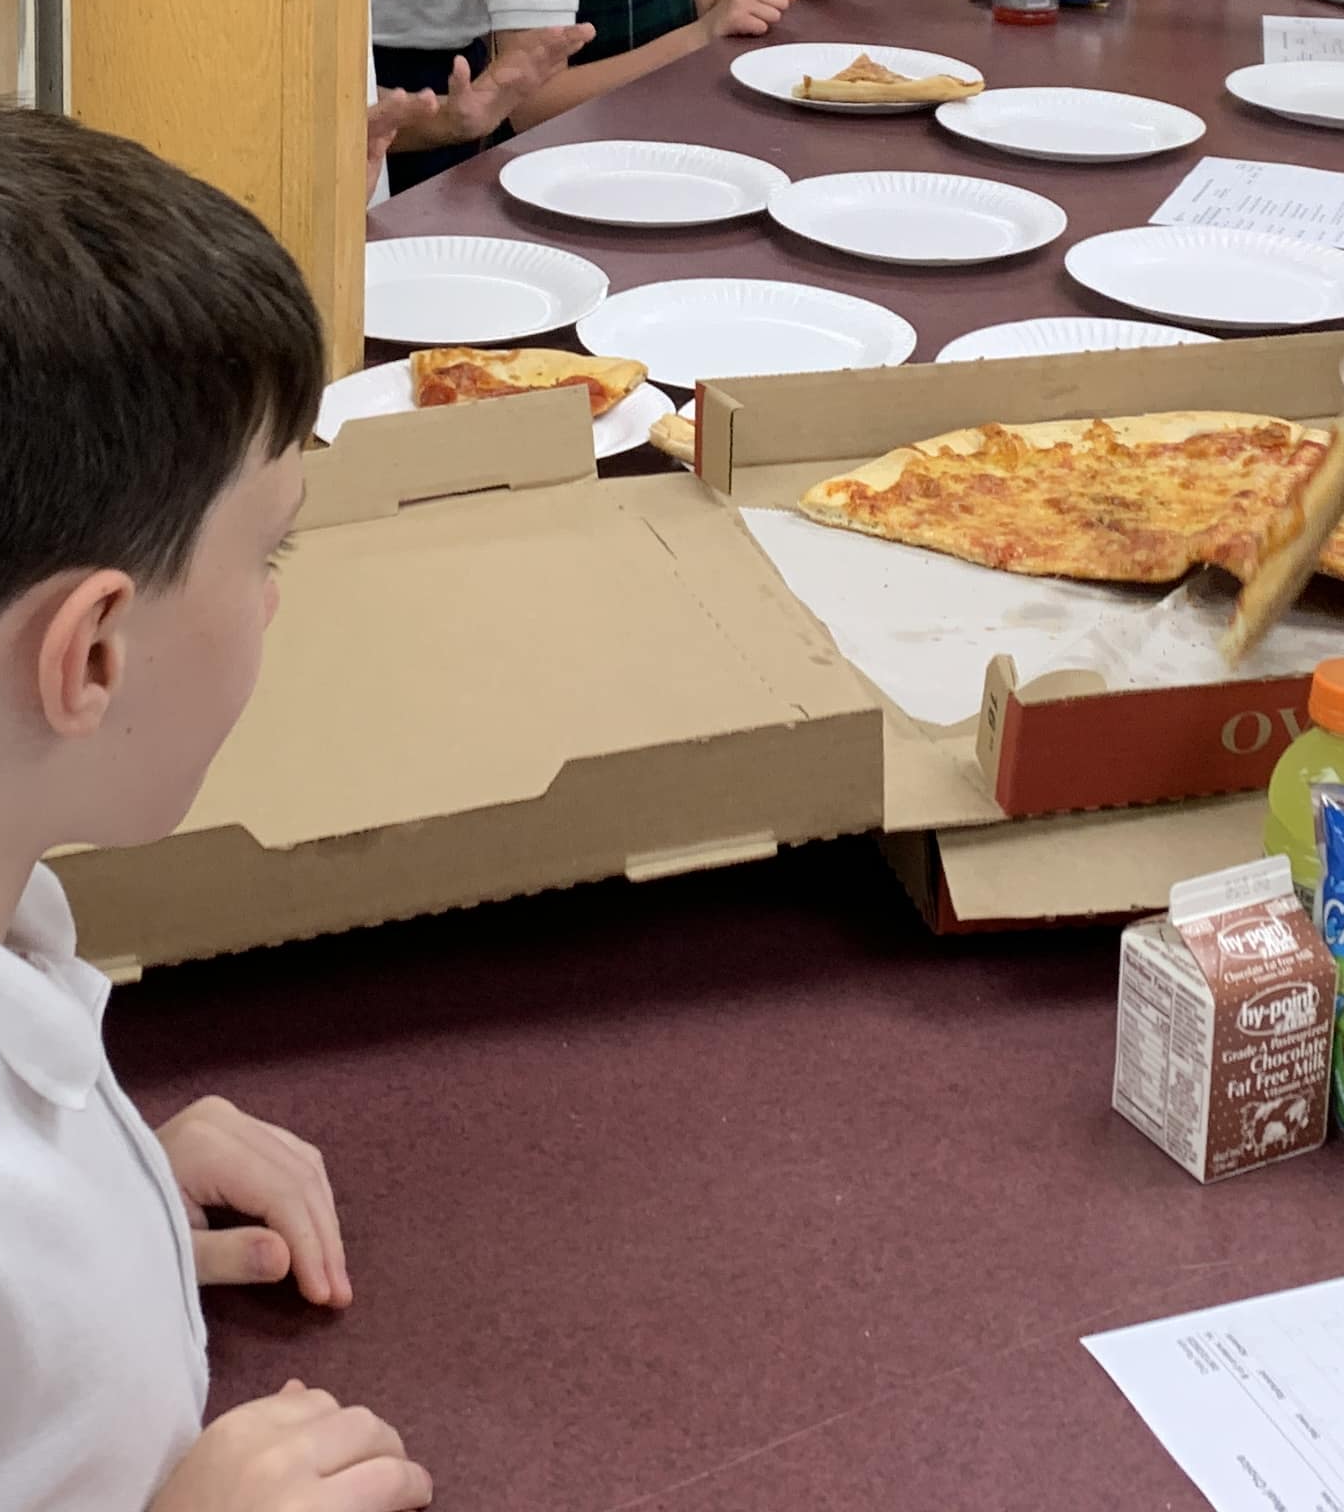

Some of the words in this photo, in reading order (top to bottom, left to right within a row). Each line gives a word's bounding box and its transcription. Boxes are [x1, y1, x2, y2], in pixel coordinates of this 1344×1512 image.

[1240, 982, 1317, 1029] hy-point
[1222, 1044, 1258, 1064] Grade
[1259, 1040, 1269, 1054] A
[1249, 1037, 1328, 1075] Chocolate
[1227, 1078, 1252, 1100] Fat
[1255, 1066, 1291, 1092] Free
[1292, 1052, 1327, 1081] Milk
